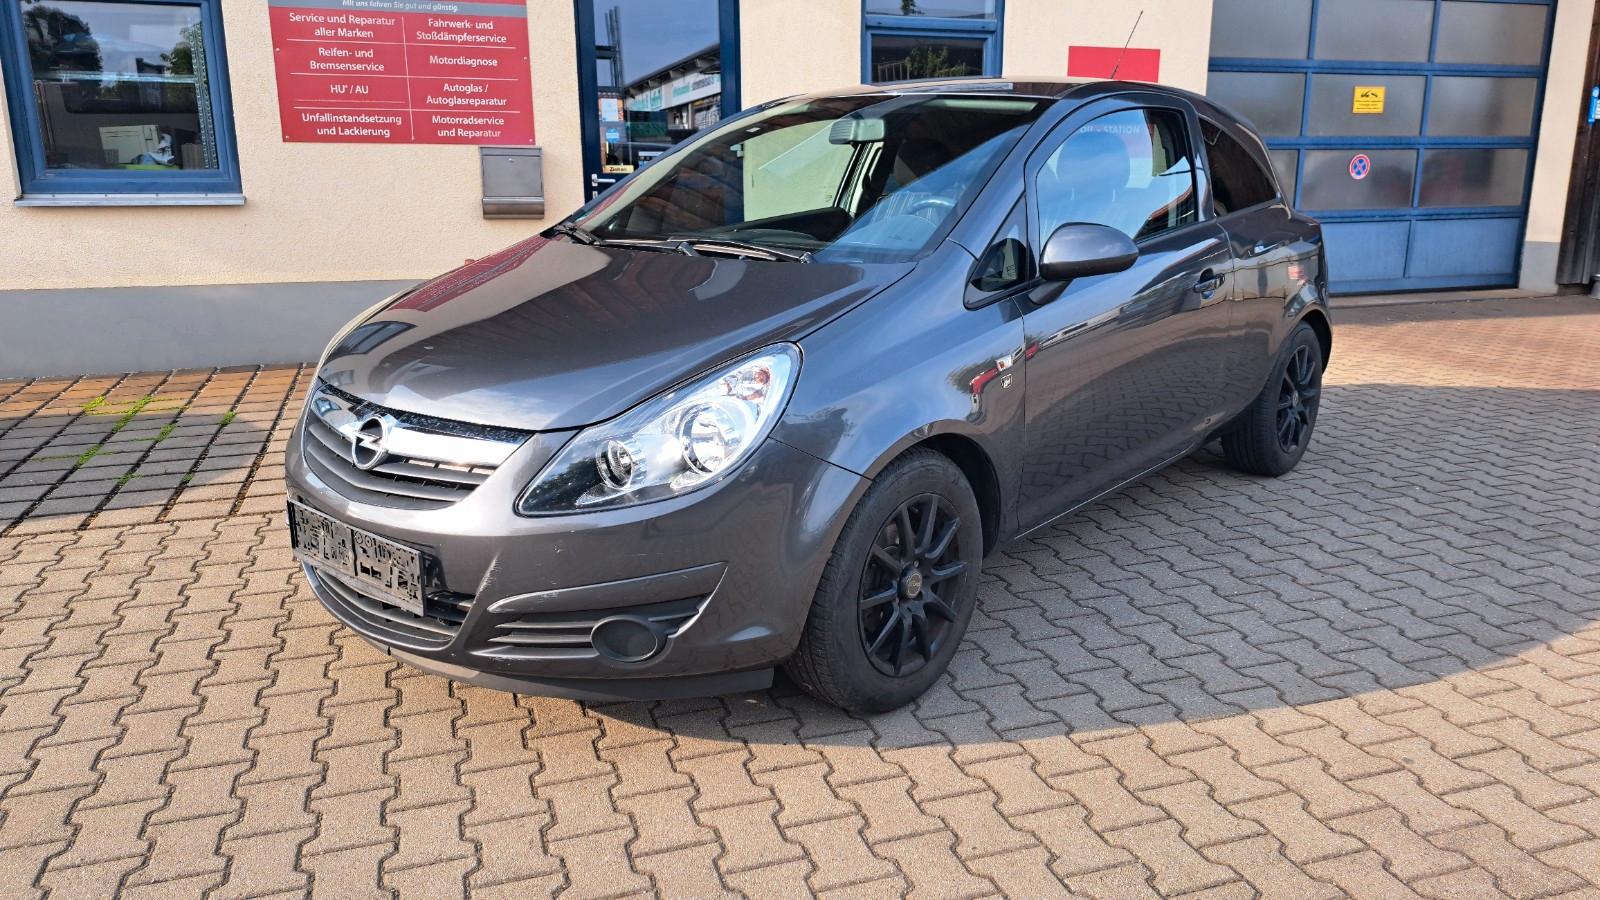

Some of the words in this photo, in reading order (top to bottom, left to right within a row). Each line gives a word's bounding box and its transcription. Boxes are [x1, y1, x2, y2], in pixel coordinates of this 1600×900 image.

[289, 13, 325, 23] Service
[327, 14, 346, 24] und
[348, 15, 395, 26] Reparatur
[428, 18, 473, 29] Fahrwerk-
[475, 20, 493, 30] und
[314, 27, 335, 37] aller
[338, 28, 374, 38] Marken
[416, 31, 507, 44] Stoßdämpferservice
[319, 47, 353, 58] Reifen-
[354, 48, 373, 58] und
[310, 60, 385, 71] Bremsenservice
[429, 55, 498, 68] Motordiagnose
[355, 85, 369, 94] AU
[442, 83, 483, 94] Autoglas
[426, 95, 507, 108] Autoglasreparatur
[302, 112, 402, 126] Unfallinstandsetzung
[431, 115, 505, 126] Motorradservice
[317, 126, 336, 136] und
[338, 126, 391, 139] Lackierung
[437, 128, 456, 137] und
[457, 128, 501, 140] Reparatur
[1103, 125, 1140, 135] STATION
